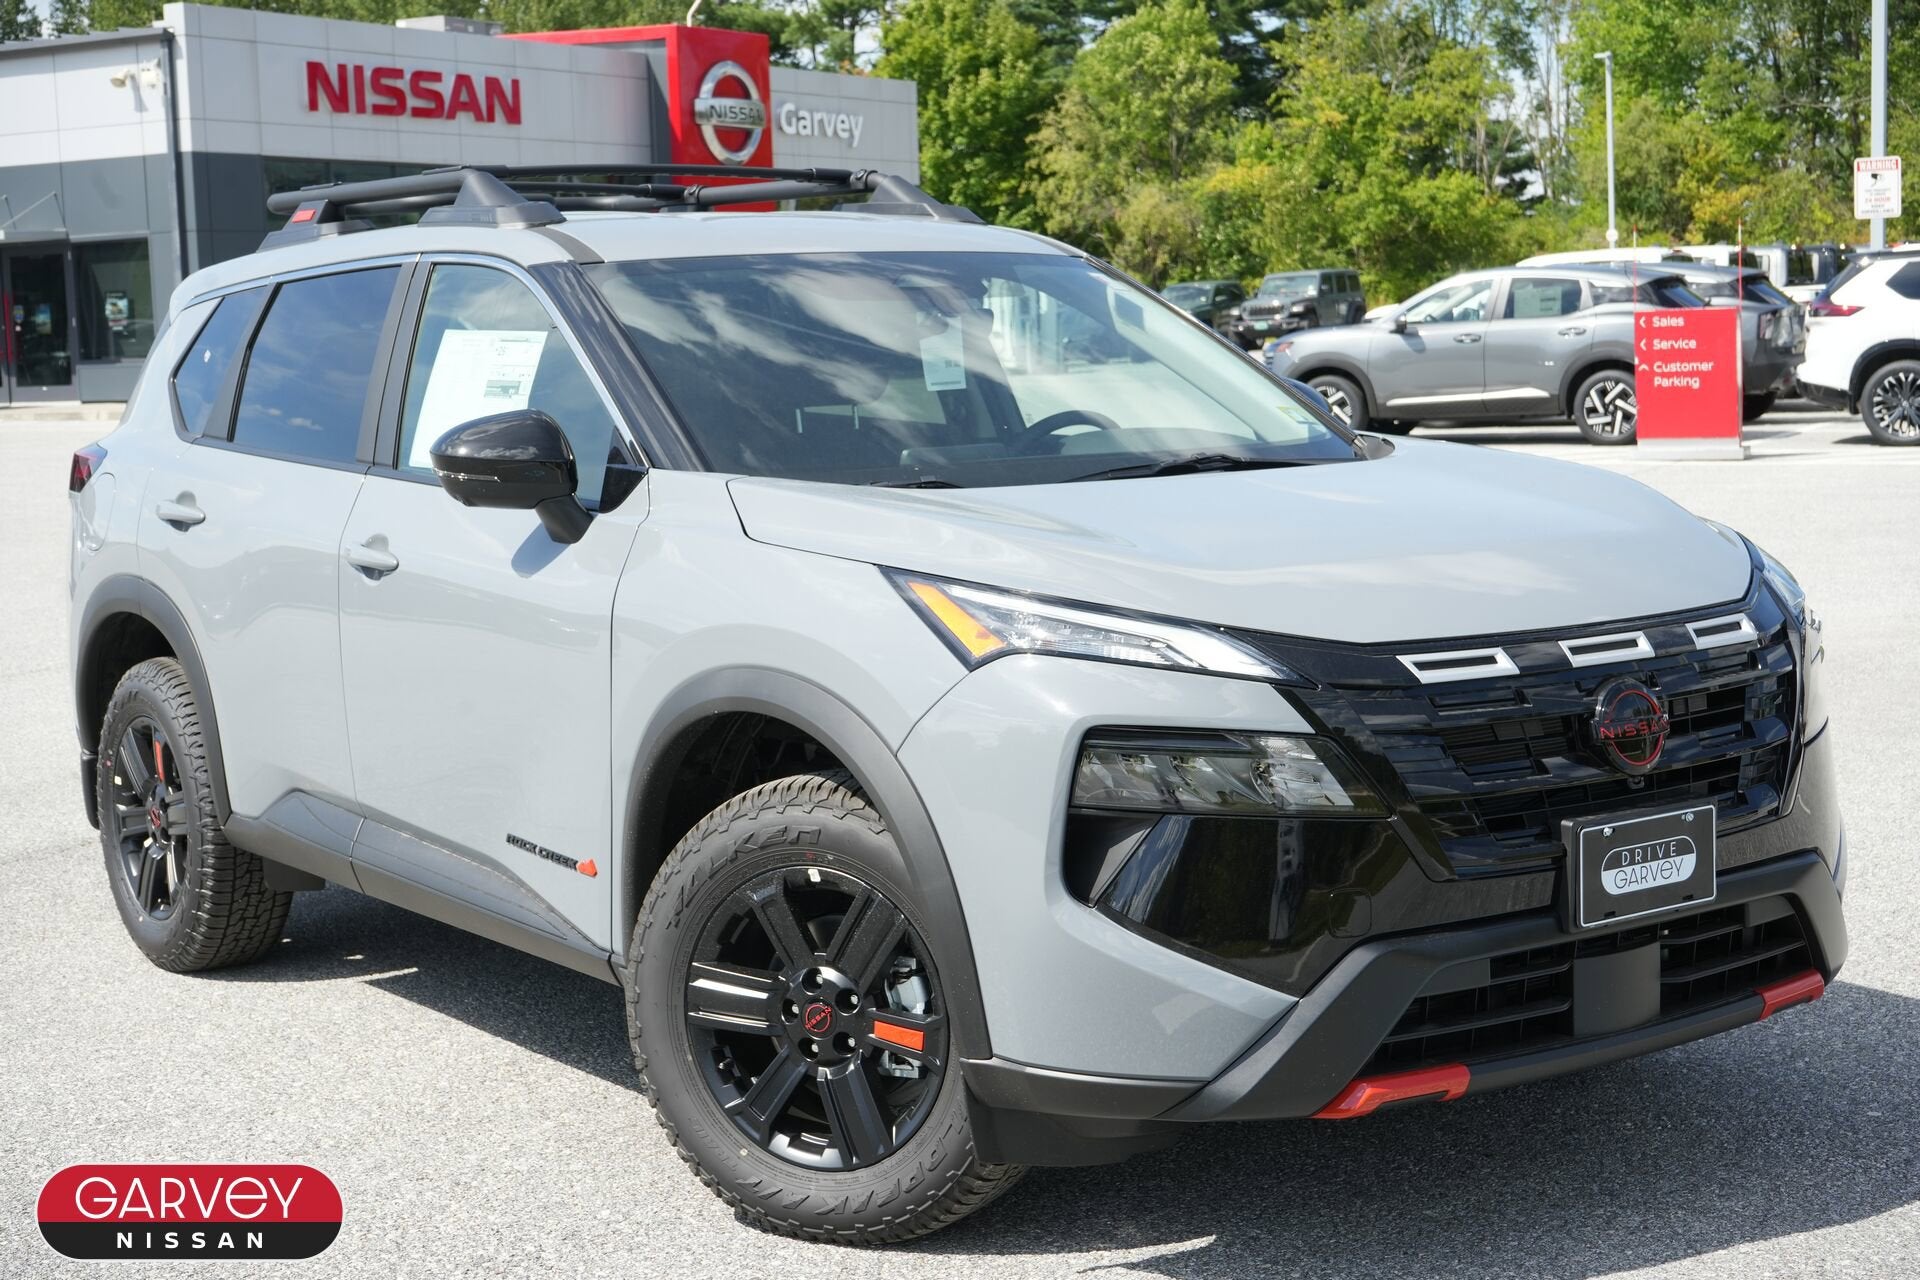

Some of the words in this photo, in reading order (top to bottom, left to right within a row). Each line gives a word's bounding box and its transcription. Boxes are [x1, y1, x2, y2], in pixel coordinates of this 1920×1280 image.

[306, 61, 522, 125] NISSAN
[709, 104, 764, 121] NISSAN
[780, 102, 864, 148] Garvey
[1652, 316, 1685, 327] Sales
[1653, 338, 1697, 350] Service
[1653, 360, 1714, 373] Customer
[1654, 375, 1700, 389] Parking
[1600, 717, 1670, 740] NISSAN
[506, 833, 538, 856] ROCK
[538, 846, 579, 872] CREEK
[1621, 841, 1678, 866] DRIVE
